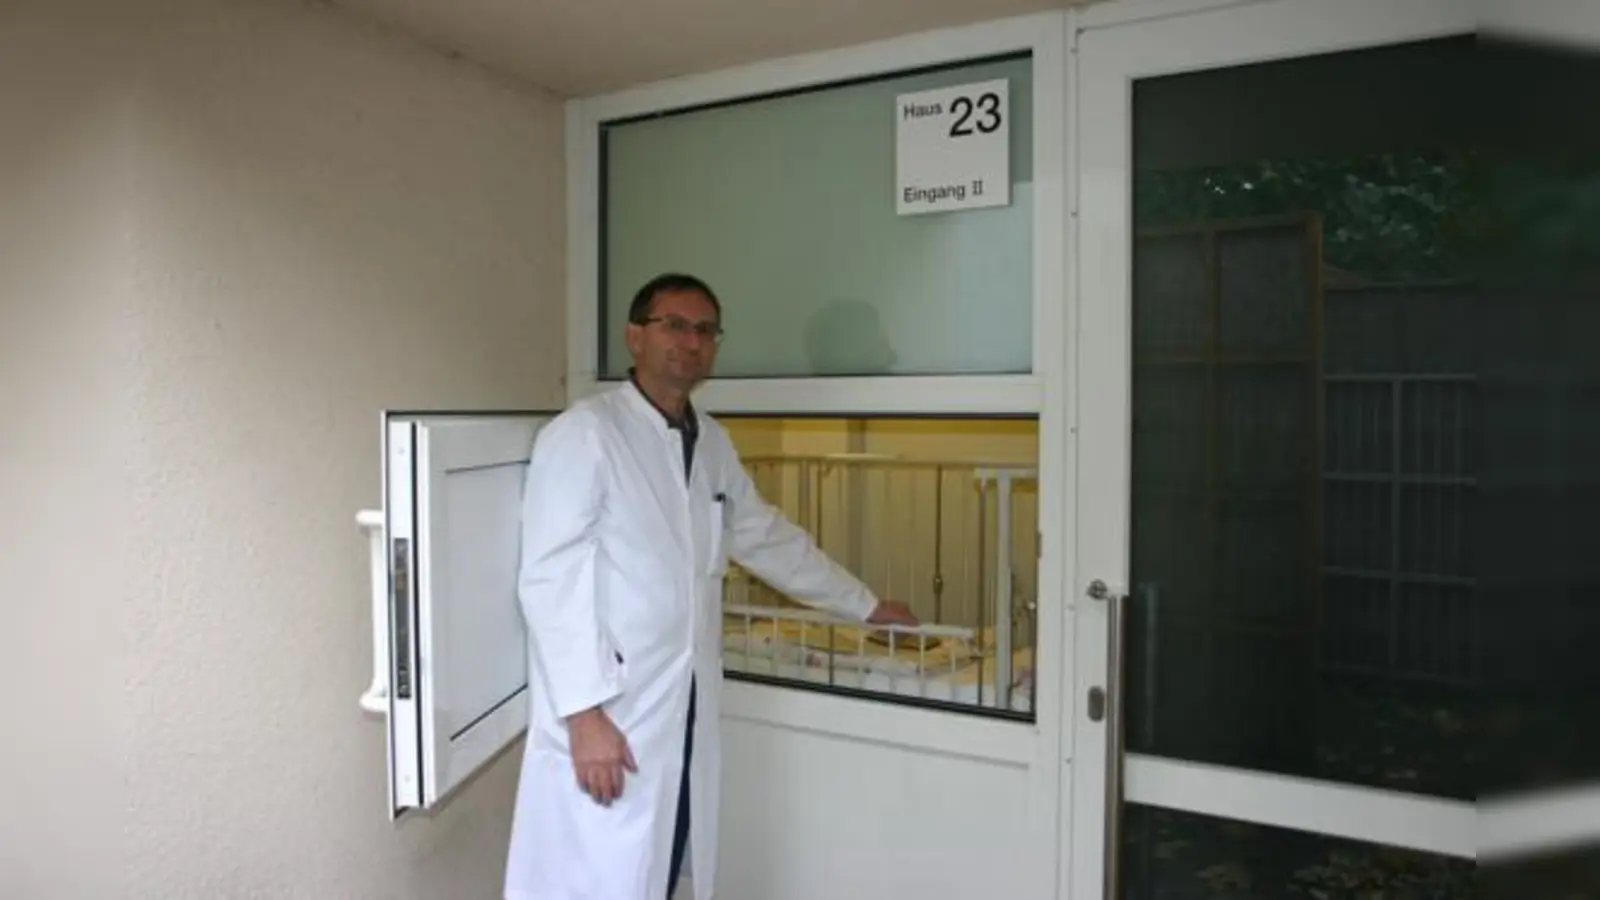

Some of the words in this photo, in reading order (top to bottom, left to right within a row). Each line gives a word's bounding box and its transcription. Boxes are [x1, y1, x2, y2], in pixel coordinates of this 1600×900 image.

[903, 102, 943, 119] Haus
[949, 92, 1002, 138] 23
[903, 185, 966, 203] Eingang
[972, 180, 984, 195] II
